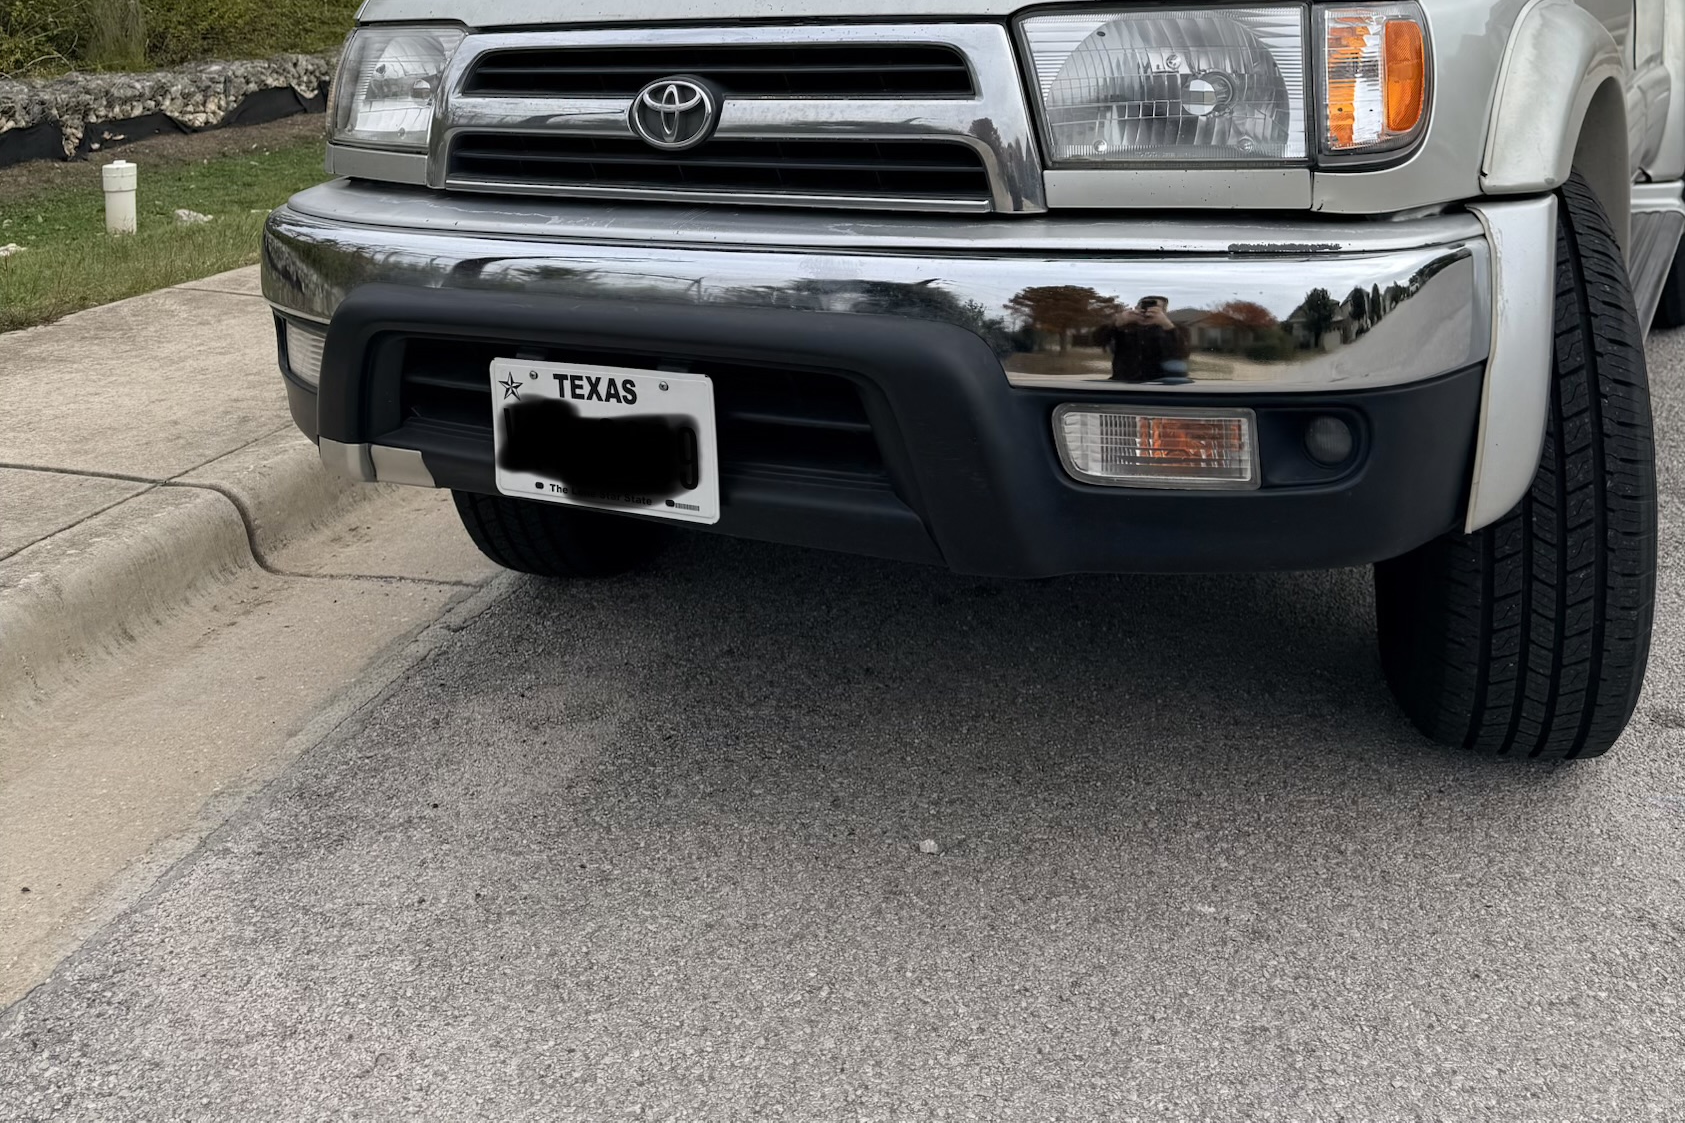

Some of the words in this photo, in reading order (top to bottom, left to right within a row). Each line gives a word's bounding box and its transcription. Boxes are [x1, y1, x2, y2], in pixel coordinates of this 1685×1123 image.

[552, 373, 638, 405] TEXAS
[549, 483, 568, 494] The
[624, 493, 652, 506] State
